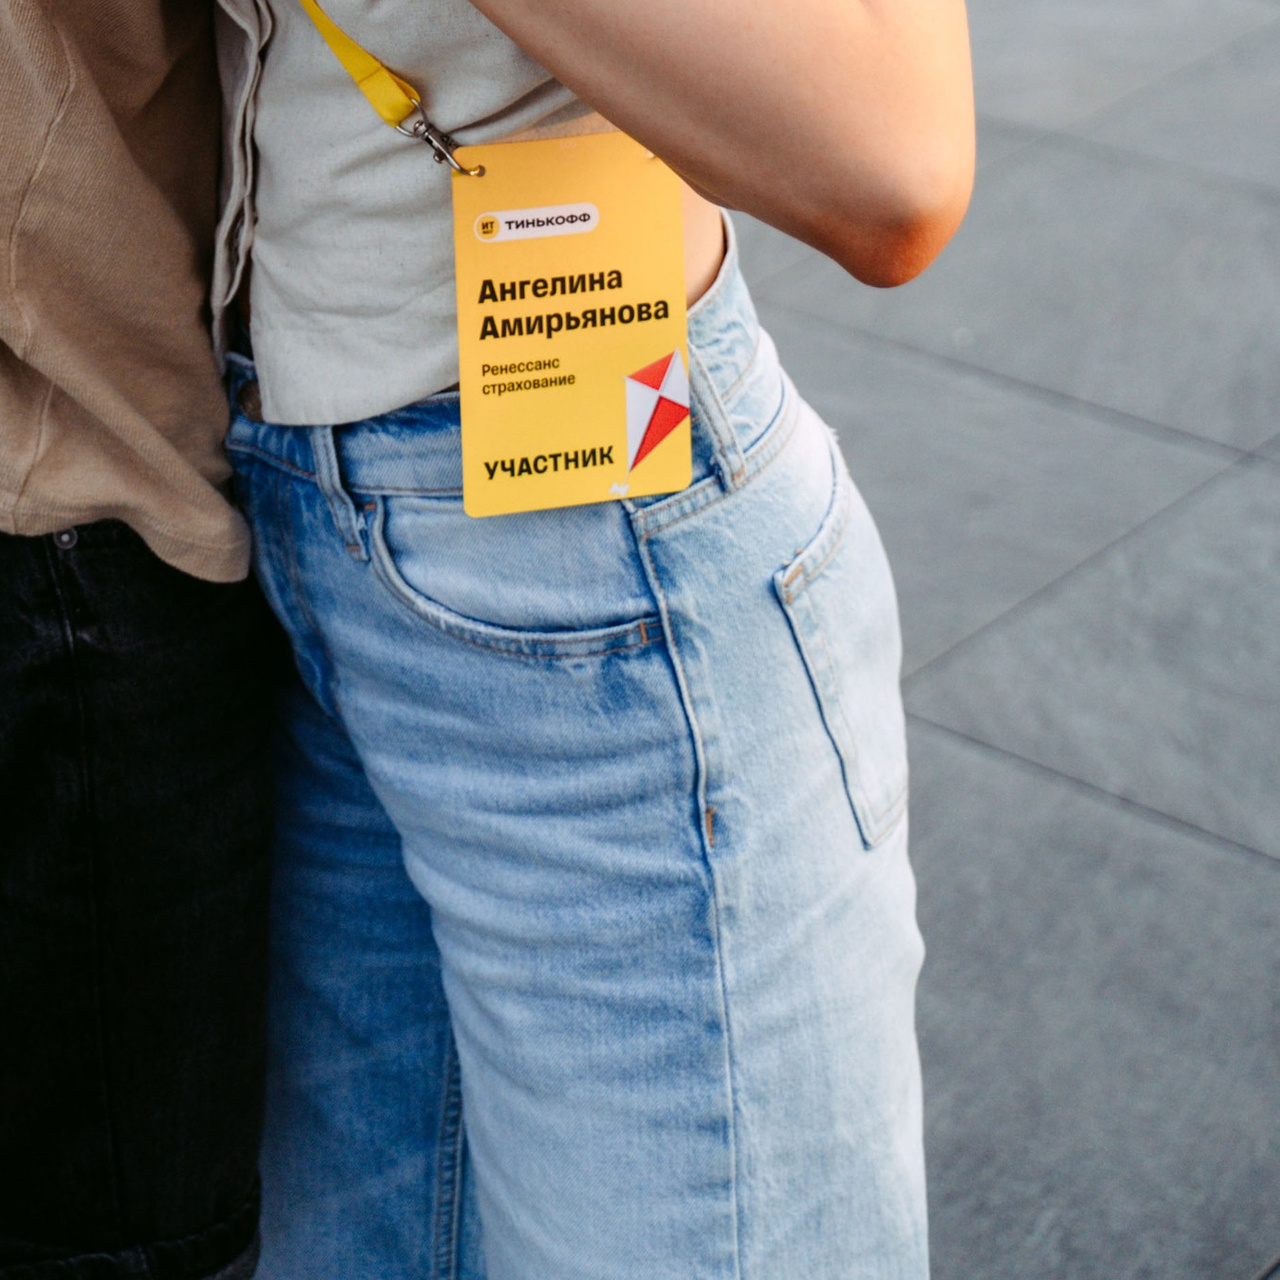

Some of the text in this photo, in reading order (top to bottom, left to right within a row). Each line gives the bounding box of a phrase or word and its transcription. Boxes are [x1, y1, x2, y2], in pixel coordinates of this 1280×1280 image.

[504, 212, 591, 230] ТИНЬКОФФ
[478, 270, 623, 304] Ангелина
[479, 300, 669, 341] Амирьянова
[481, 358, 560, 377] Ренессанс
[482, 374, 576, 397] страхование
[484, 445, 614, 481] УЧАСТНИК
